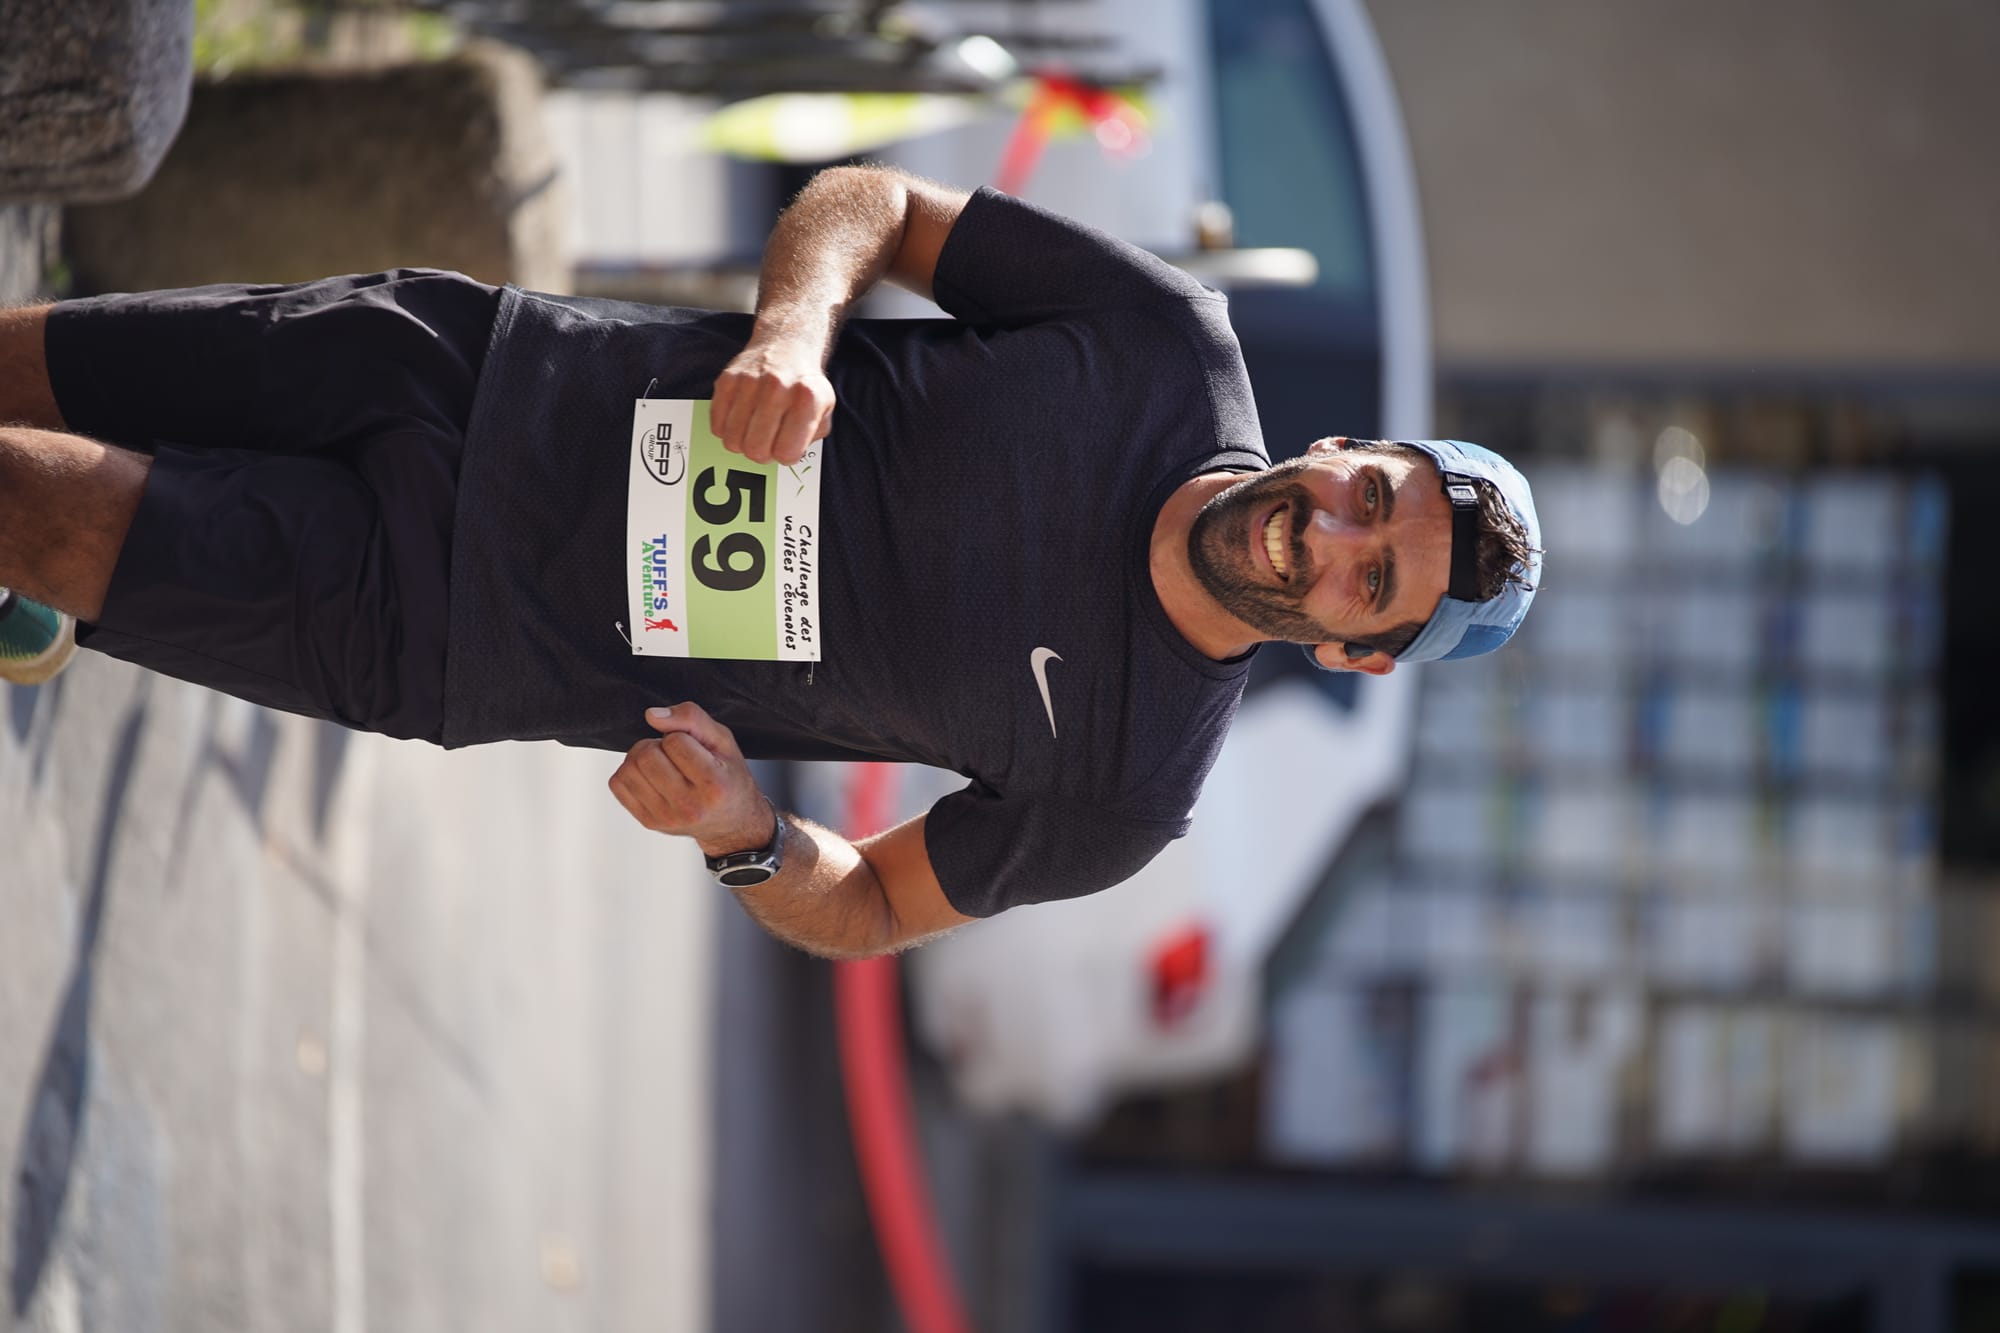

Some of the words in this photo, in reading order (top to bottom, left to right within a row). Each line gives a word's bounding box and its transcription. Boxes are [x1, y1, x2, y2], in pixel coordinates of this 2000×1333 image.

[648, 434, 656, 460] GROUP
[657, 423, 672, 476] BFP
[691, 466, 767, 592] 59
[783, 516, 796, 572] vallées
[642, 541, 656, 618] Aventure
[654, 534, 668, 610] TUFF'S
[795, 524, 813, 606] Challenge
[783, 583, 798, 650] cévenoles
[801, 616, 812, 642] des
